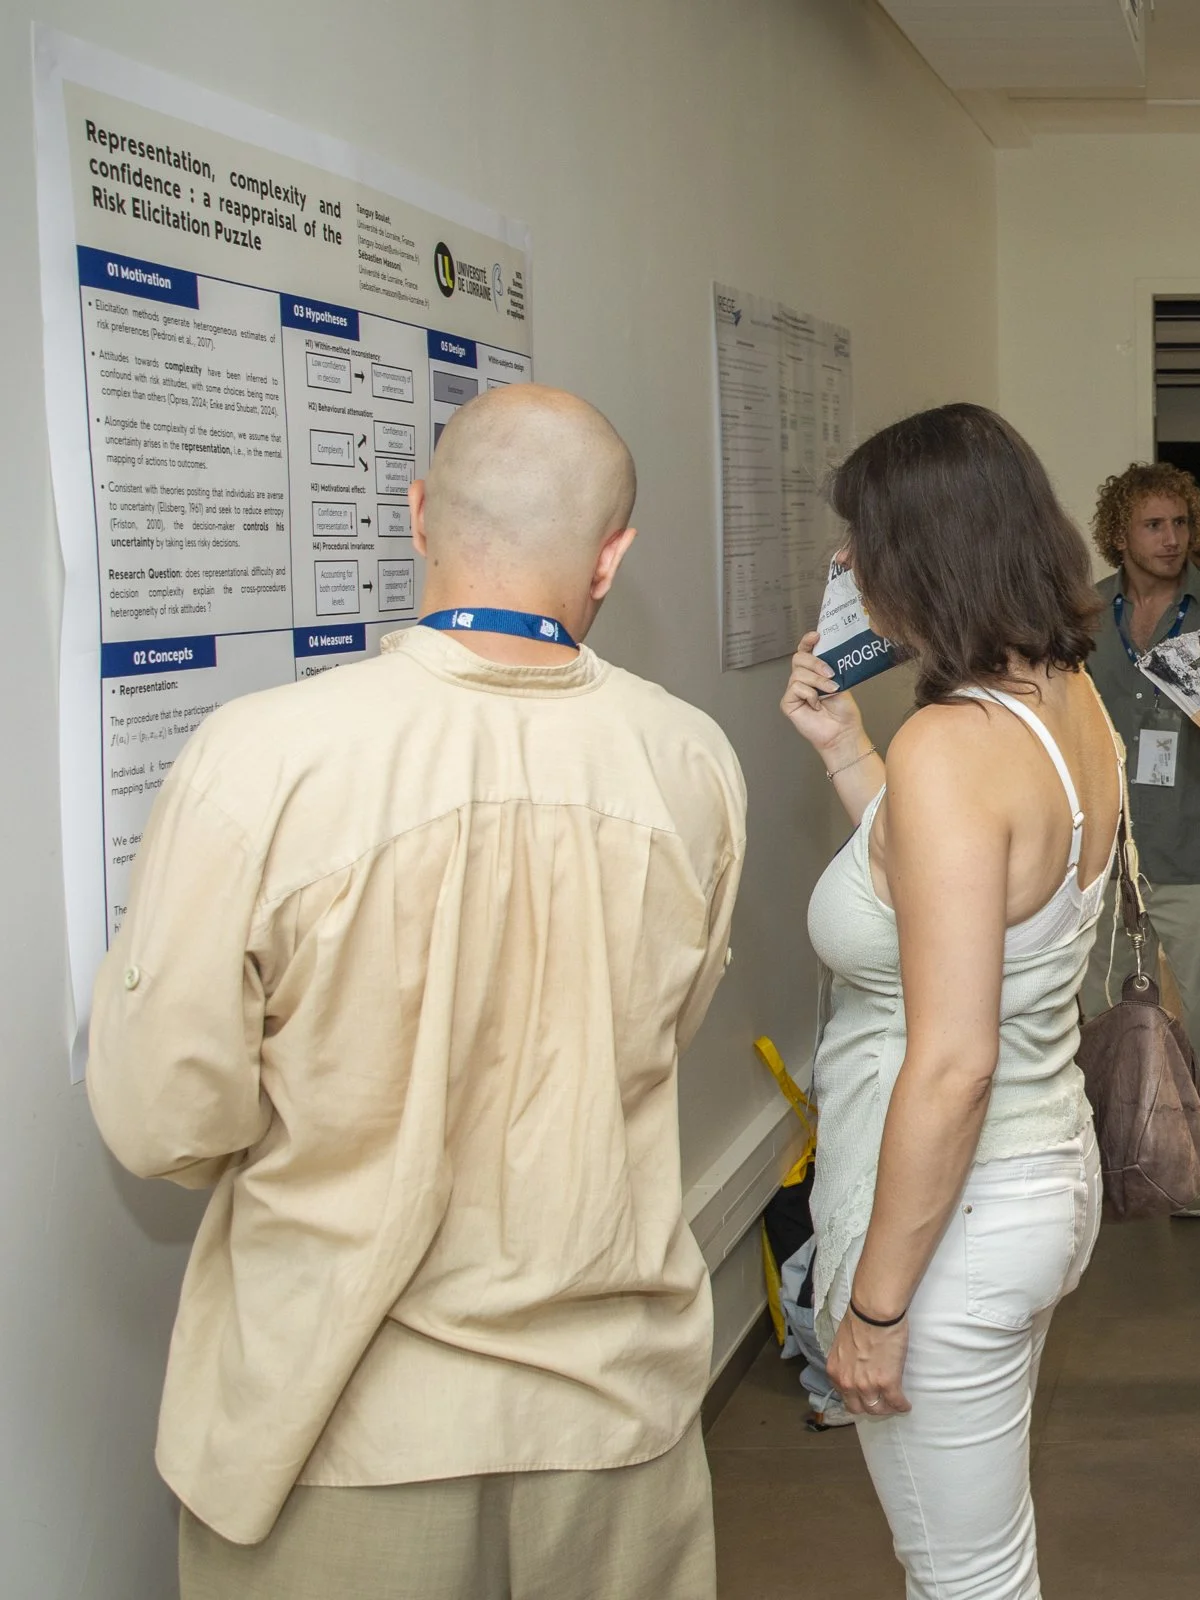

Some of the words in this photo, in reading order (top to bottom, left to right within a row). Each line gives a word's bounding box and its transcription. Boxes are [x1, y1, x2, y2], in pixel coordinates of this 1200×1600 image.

[85, 119, 215, 182] Representation,
[230, 170, 306, 211] complexity
[320, 200, 341, 218] and
[89, 158, 181, 198] confidence
[203, 192, 211, 208] a
[220, 197, 297, 232] reappraisal
[304, 220, 316, 237] of
[324, 224, 341, 245] the
[92, 186, 126, 215] Risk
[132, 197, 210, 238] Elicitation
[215, 221, 261, 250] Puzzle
[107, 262, 118, 276] 01
[121, 266, 171, 289] Motivation
[456, 261, 487, 284] UNIVERSITÉ
[458, 277, 466, 292] DE
[466, 280, 491, 301] LORRAINE
[95, 299, 128, 315] Elicitation
[132, 308, 159, 322] methods
[163, 314, 190, 328] generate
[194, 318, 237, 336] heterogeneous
[241, 329, 266, 342] estimates
[270, 334, 275, 343] of
[294, 305, 303, 317] 03
[306, 307, 347, 326] Hypotheses
[97, 320, 109, 330] risk
[112, 322, 149, 337] preferences
[151, 329, 176, 343] (Pedroni
[178, 335, 184, 343] et
[441, 341, 448, 351] 05
[449, 343, 465, 357] Design
[99, 350, 129, 363] Attitudes
[135, 356, 159, 368] towards
[165, 360, 202, 374] complexity
[208, 366, 221, 378] have
[226, 369, 240, 379] been
[246, 372, 267, 384] inferred
[272, 376, 278, 385] to
[101, 369, 131, 380] confound
[134, 373, 147, 383] with
[150, 375, 159, 385] risk
[192, 380, 203, 390] with
[206, 384, 221, 393] some
[223, 385, 244, 396] choices
[247, 390, 263, 400] being
[266, 393, 279, 401] more
[102, 386, 131, 398] complex
[132, 389, 146, 400] than
[147, 392, 166, 402] others
[210, 399, 223, 409] Enke
[225, 401, 234, 411] and
[105, 416, 138, 430] Alongside
[141, 419, 150, 430] the
[153, 421, 187, 435] complexity
[190, 424, 196, 435] of
[198, 426, 207, 436] the
[249, 432, 269, 441] assume
[271, 433, 281, 443] that
[106, 436, 141, 449] uncertainty
[144, 438, 160, 449] arises
[163, 440, 168, 449] in
[170, 440, 179, 450] the
[182, 442, 232, 457] representation,
[253, 447, 262, 457] the
[107, 454, 135, 466] mapping
[137, 455, 143, 465] of
[146, 457, 167, 466] actions
[169, 458, 175, 467] to
[109, 482, 142, 493] Consistent
[145, 485, 158, 494] with
[160, 486, 184, 496] theories
[187, 488, 210, 499] positing
[212, 488, 223, 498] that
[225, 488, 254, 499] individuals
[267, 492, 283, 500] averse
[110, 502, 116, 510] to
[120, 502, 155, 514] uncertainty
[205, 505, 216, 514] and
[219, 505, 232, 514] seek
[235, 506, 240, 514] to
[243, 506, 261, 516] reduce
[264, 507, 284, 516] entropy
[174, 521, 183, 530] the
[192, 521, 235, 531] decision-maker
[243, 522, 269, 531] controls
[276, 523, 284, 531] his
[111, 537, 154, 550] uncertainty
[156, 539, 164, 549] by
[165, 539, 183, 550] taking
[185, 538, 196, 548] less
[198, 538, 210, 549] risky
[109, 569, 145, 580] Research
[149, 568, 182, 580] Question:
[185, 568, 200, 577] does
[276, 567, 285, 576] and
[110, 588, 139, 599] decision
[149, 587, 184, 600] complexity
[193, 586, 214, 597] explain
[223, 586, 232, 594] the
[240, 584, 286, 594] cross-procedures
[111, 606, 157, 619] heterogeneity
[160, 604, 166, 615] of
[168, 604, 179, 615] risk
[181, 604, 206, 614] attitudes
[843, 613, 857, 625] LEM
[309, 635, 318, 647] 04
[320, 634, 353, 646] Measures
[134, 651, 147, 665] 02
[149, 647, 193, 665] Concepts
[119, 680, 178, 698] Representation:
[111, 716, 124, 727] The
[126, 712, 159, 728] procedure
[161, 710, 172, 722] that
[173, 708, 183, 720] the
[111, 763, 145, 779] Individual
[111, 783, 143, 796] mapping
[113, 836, 127, 847] We
